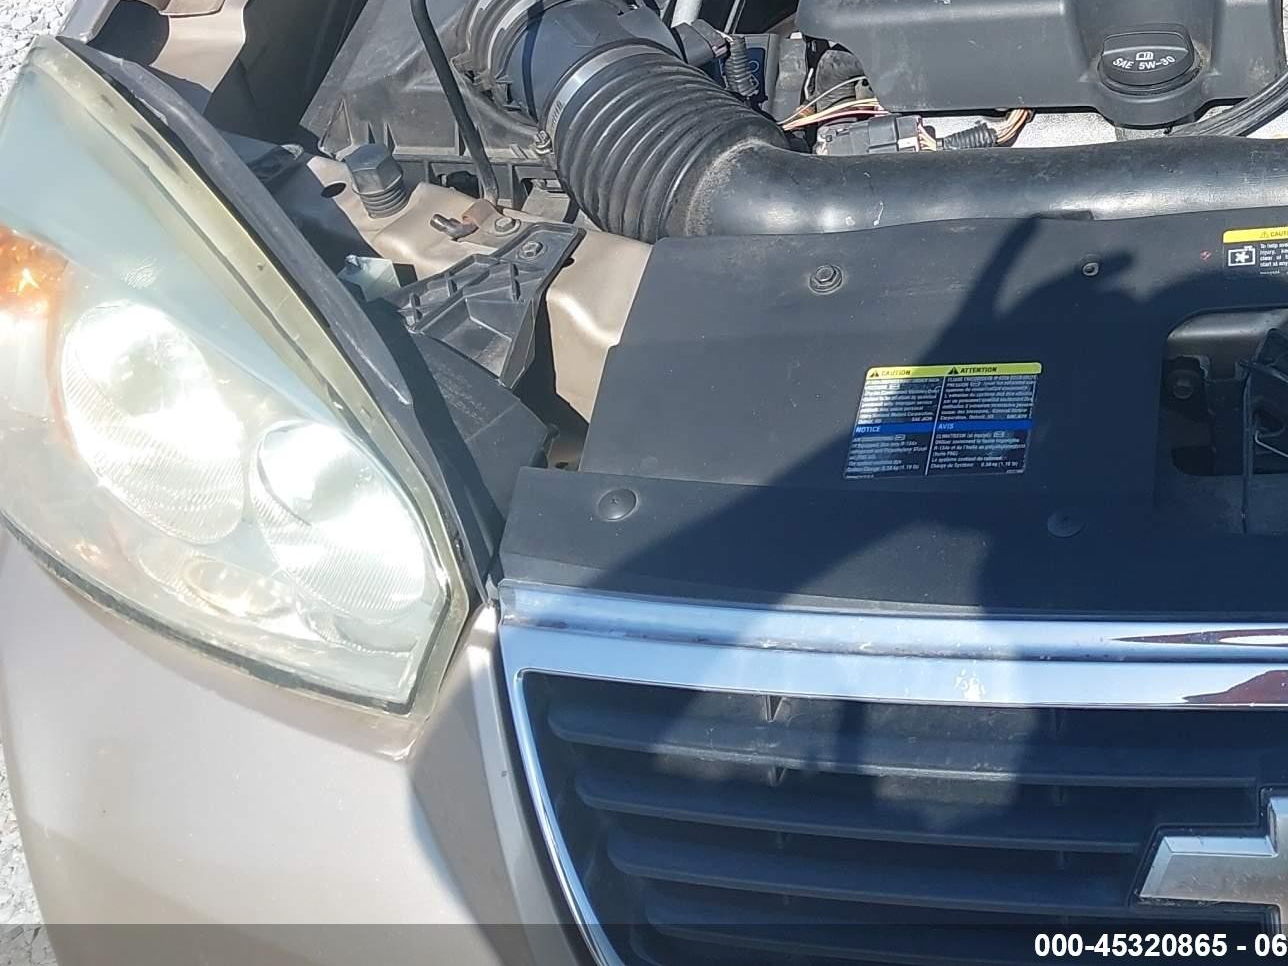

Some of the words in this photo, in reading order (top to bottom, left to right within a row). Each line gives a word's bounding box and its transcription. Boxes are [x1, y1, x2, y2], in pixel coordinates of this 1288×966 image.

[1112, 57, 1135, 70] SAE
[1138, 55, 1176, 70] 5W-30
[959, 366, 998, 374] ATTENTION
[855, 425, 881, 433] NOTICE
